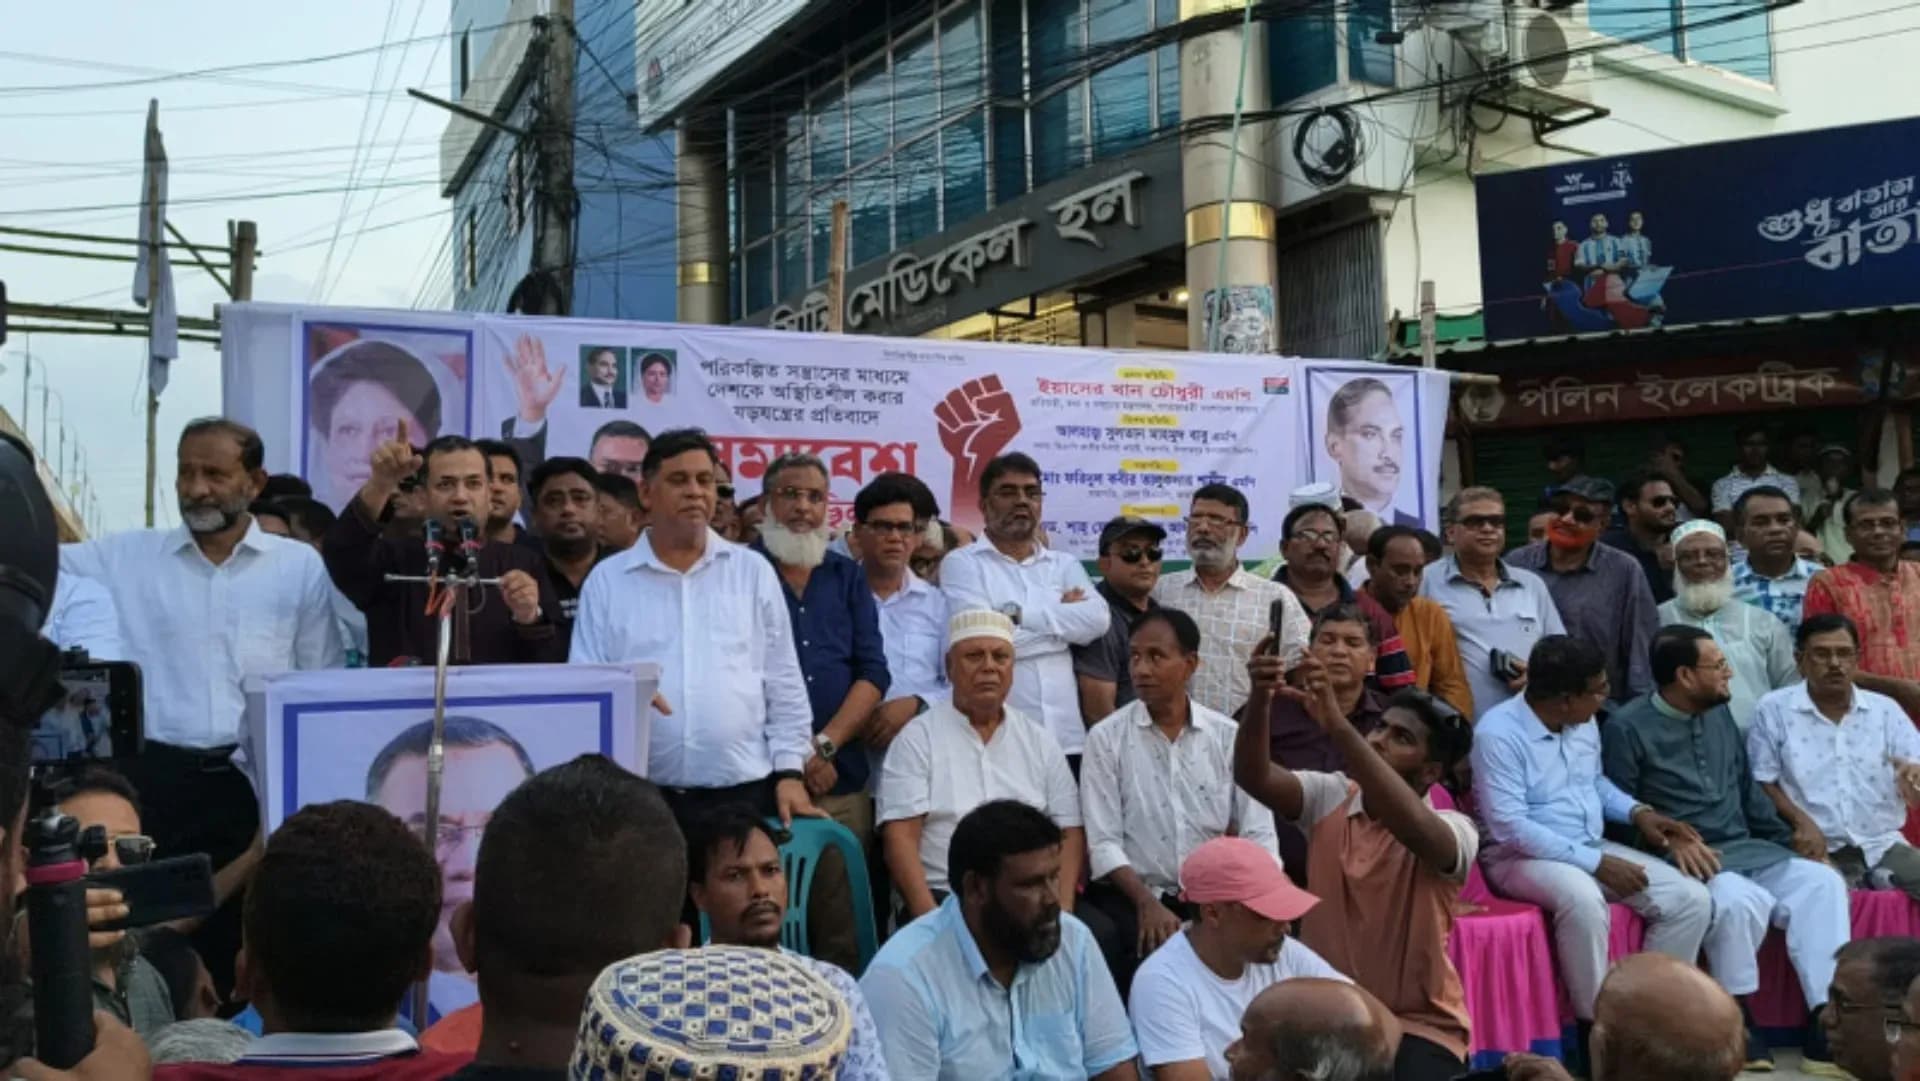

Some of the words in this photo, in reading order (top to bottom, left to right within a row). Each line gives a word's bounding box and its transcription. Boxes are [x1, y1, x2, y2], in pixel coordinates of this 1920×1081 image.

[1758, 197, 1832, 242] শুধু
[848, 217, 1034, 328] মেডিকেল
[1048, 170, 1144, 247] হল
[707, 383, 765, 398] দেশকে
[862, 390, 904, 405] করার
[1518, 376, 1625, 416] পলিন
[1635, 361, 1840, 412] ইলেকট্রিক
[810, 404, 880, 425] প্রতিবাদে
